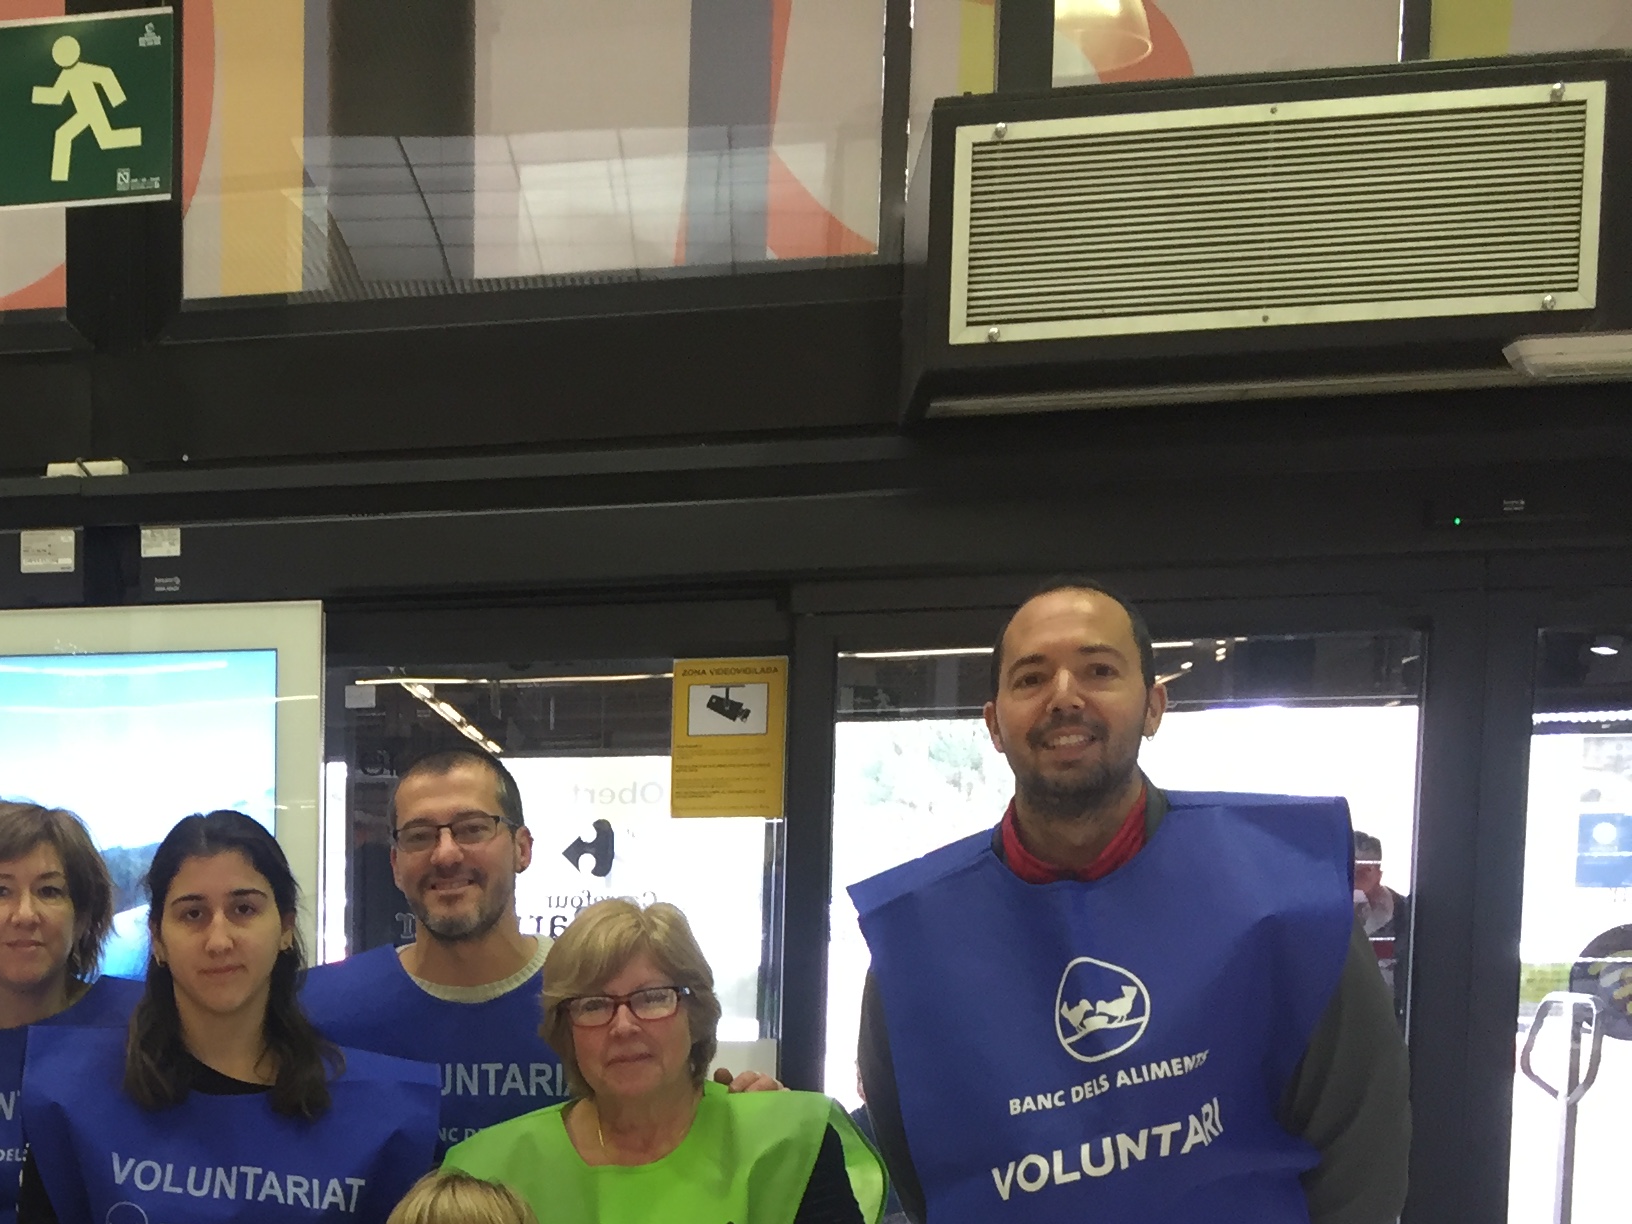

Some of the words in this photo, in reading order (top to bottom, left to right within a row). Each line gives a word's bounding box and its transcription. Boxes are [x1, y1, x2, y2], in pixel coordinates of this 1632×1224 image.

[681, 668, 707, 677] ZONA
[1009, 1090, 1065, 1115] BANC
[1071, 1074, 1110, 1104] DELS
[991, 1097, 1224, 1201] VOLUNTARI
[111, 1152, 366, 1213] VOLUNTARIAT
